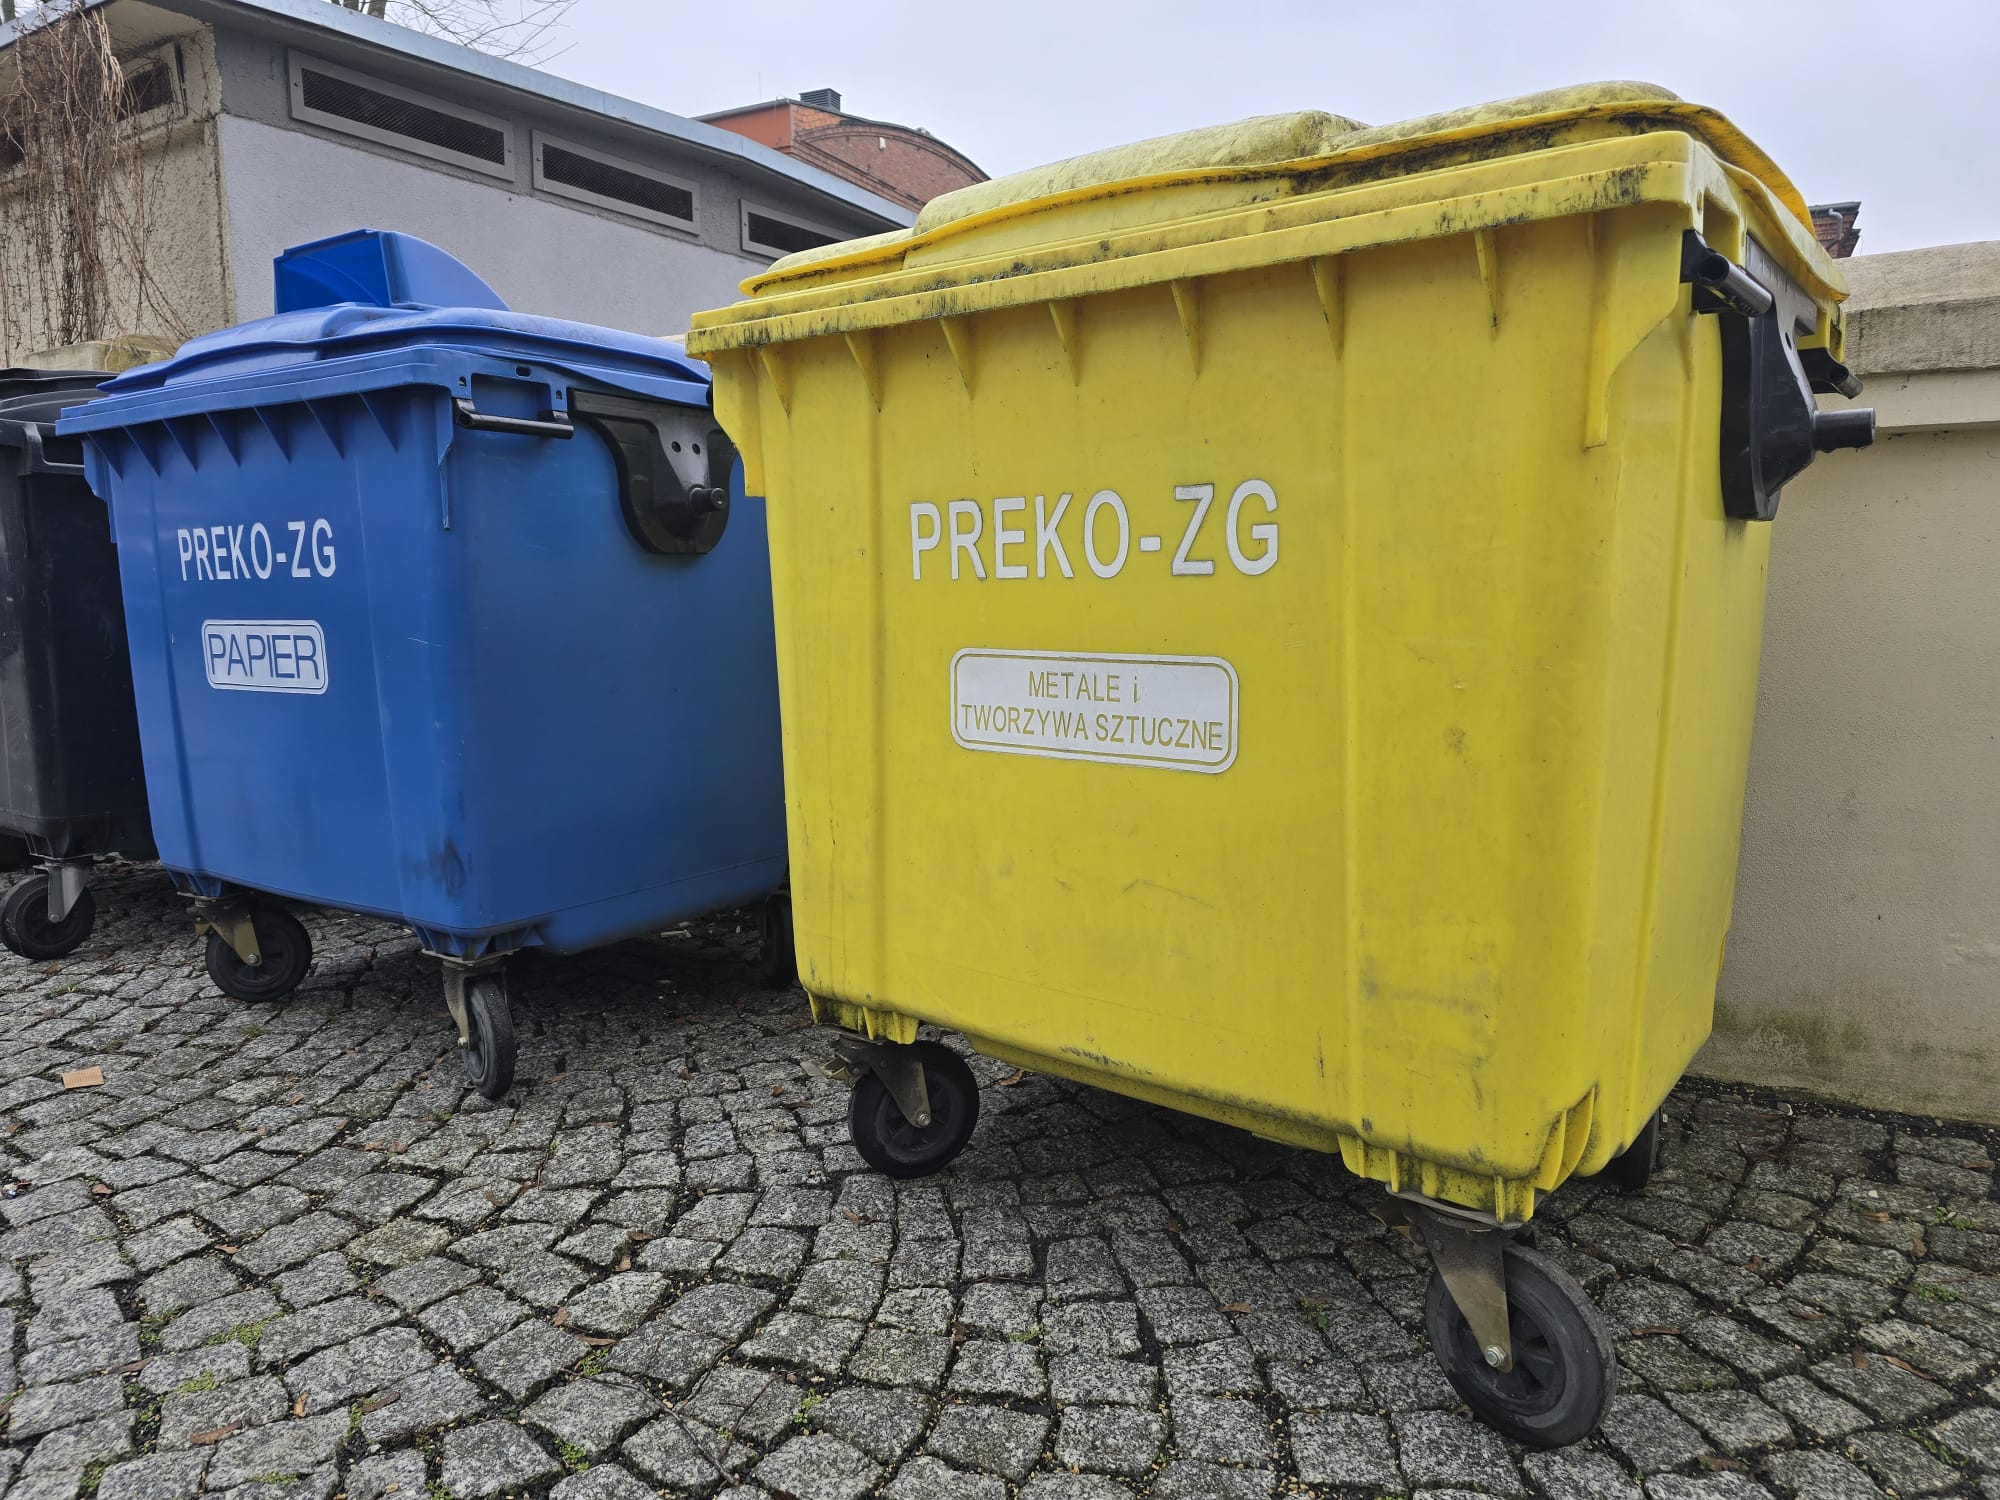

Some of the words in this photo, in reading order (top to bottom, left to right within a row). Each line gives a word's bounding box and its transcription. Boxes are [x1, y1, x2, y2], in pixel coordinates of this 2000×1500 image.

[177, 518, 336, 581] PREKO-ZG
[911, 478, 1279, 580] PREKO-ZG
[207, 633, 320, 680] PAPIER
[1028, 670, 1121, 703] METALE
[1132, 675, 1140, 703] i
[961, 703, 1089, 741] TWORZYWA
[1095, 712, 1224, 751] SZTUCZNE
